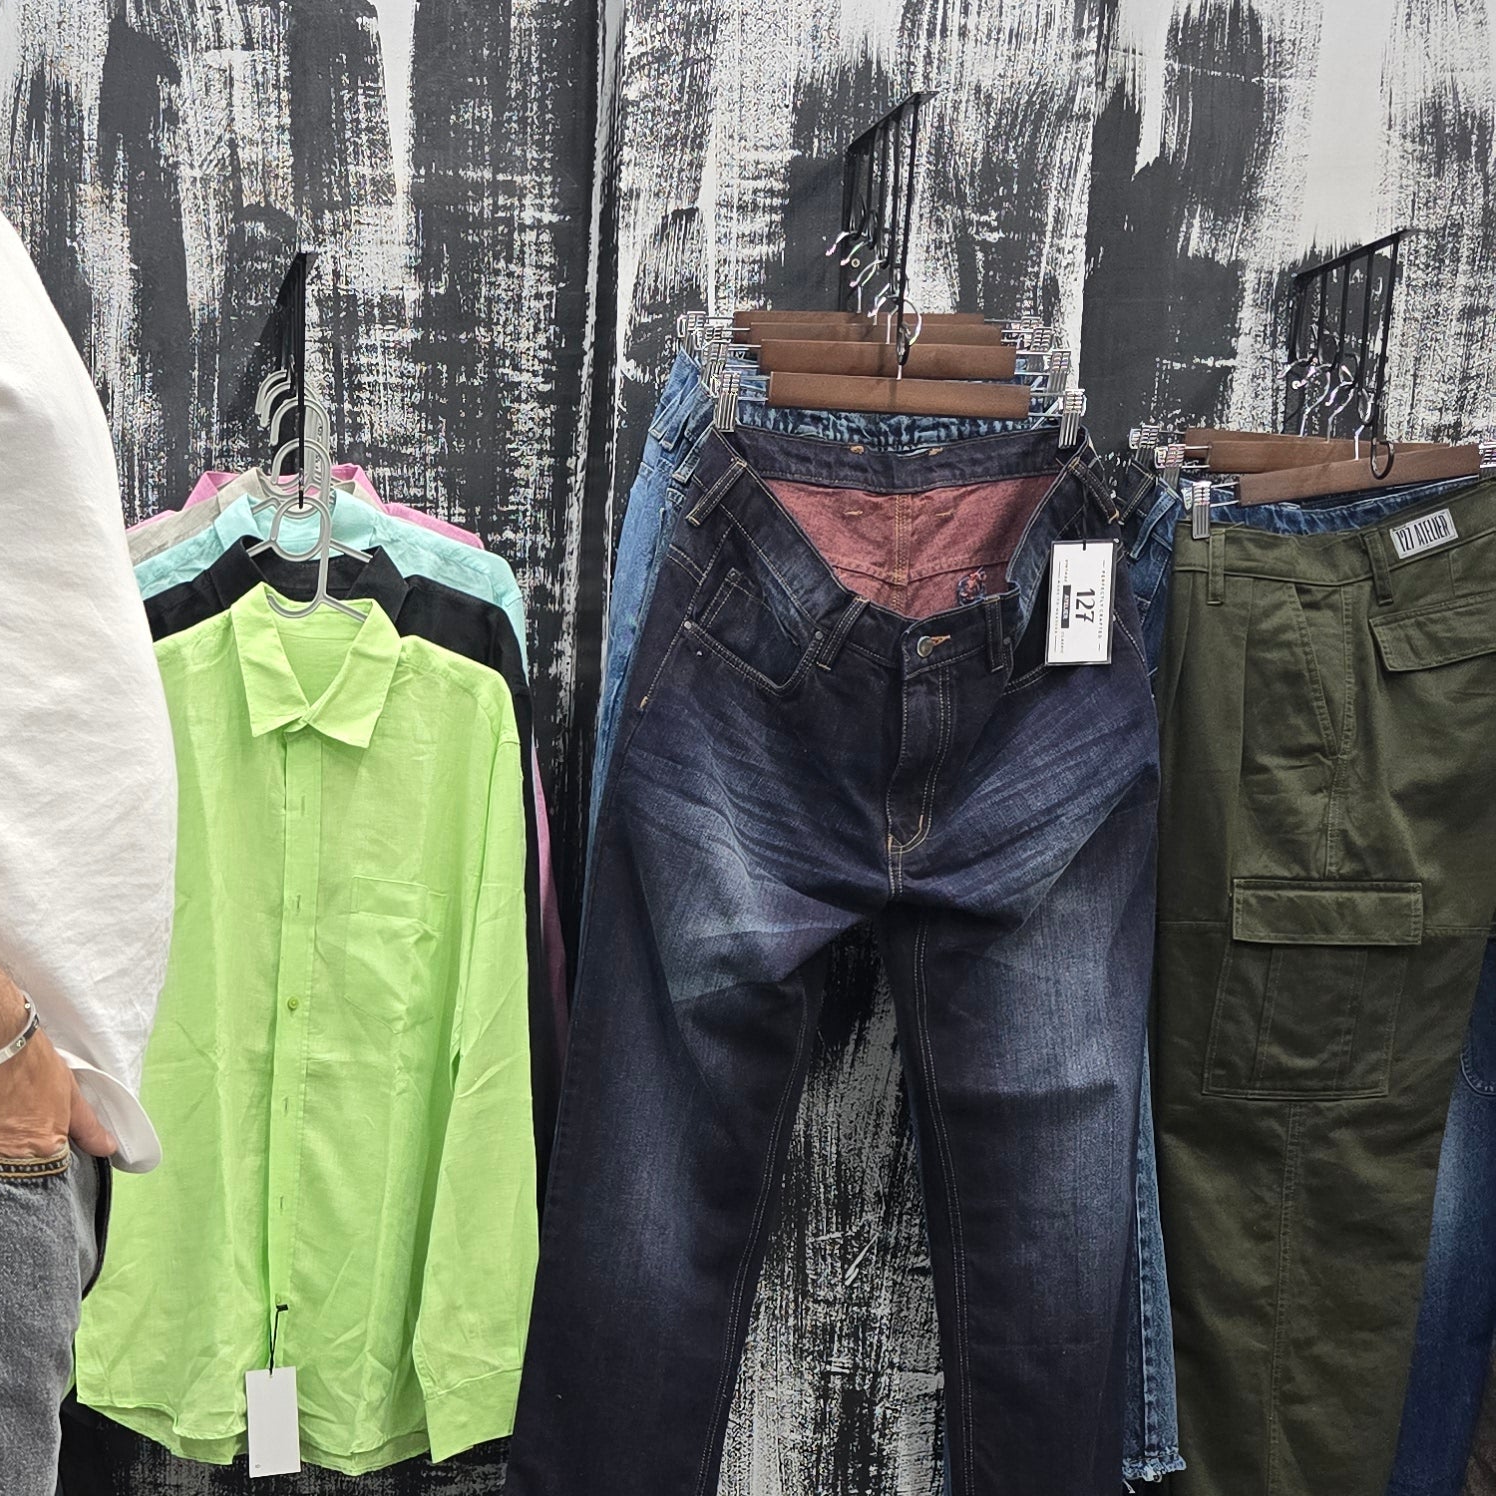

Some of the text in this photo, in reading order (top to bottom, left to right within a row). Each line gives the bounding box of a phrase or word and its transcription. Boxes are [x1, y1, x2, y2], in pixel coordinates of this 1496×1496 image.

[1396, 515, 1450, 552] 127 ATELIER
[1075, 588, 1095, 623] 127
